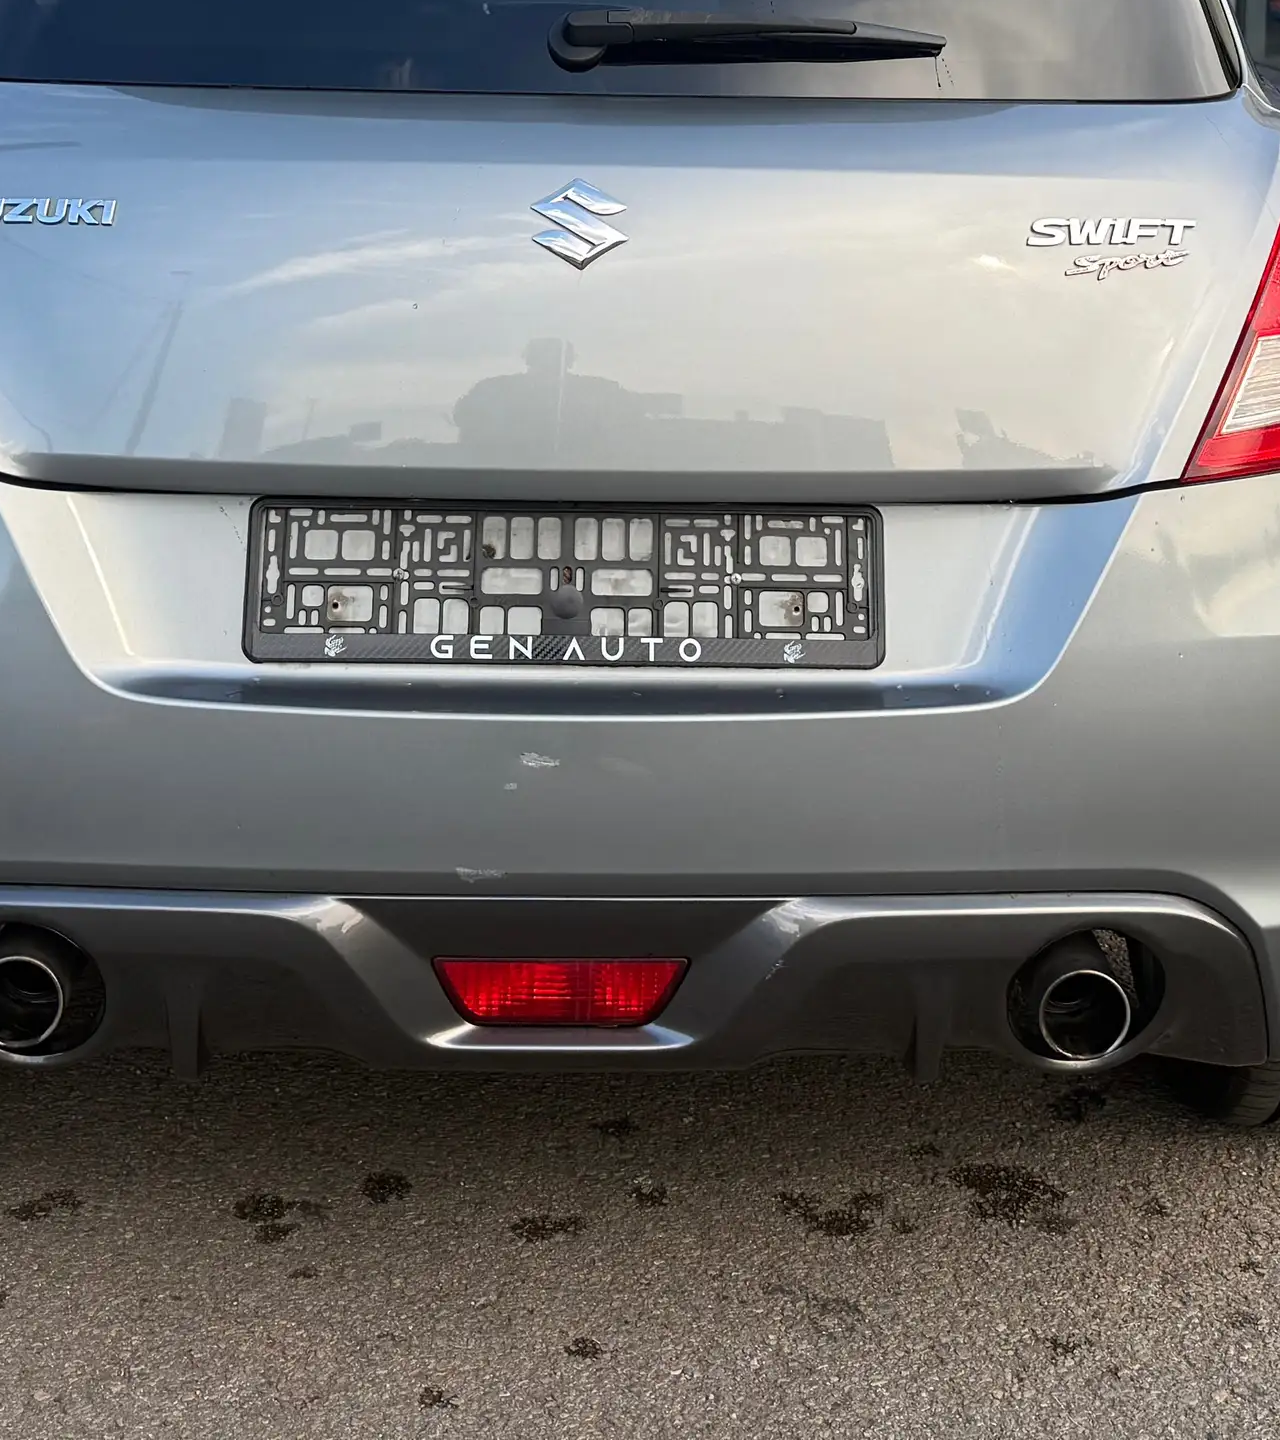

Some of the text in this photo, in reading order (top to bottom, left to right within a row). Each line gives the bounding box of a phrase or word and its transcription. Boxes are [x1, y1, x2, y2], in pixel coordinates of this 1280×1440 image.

[1025, 216, 1198, 247] SWIFT
[1064, 248, 1192, 282] Sport
[429, 633, 703, 664] GEN AUTO
